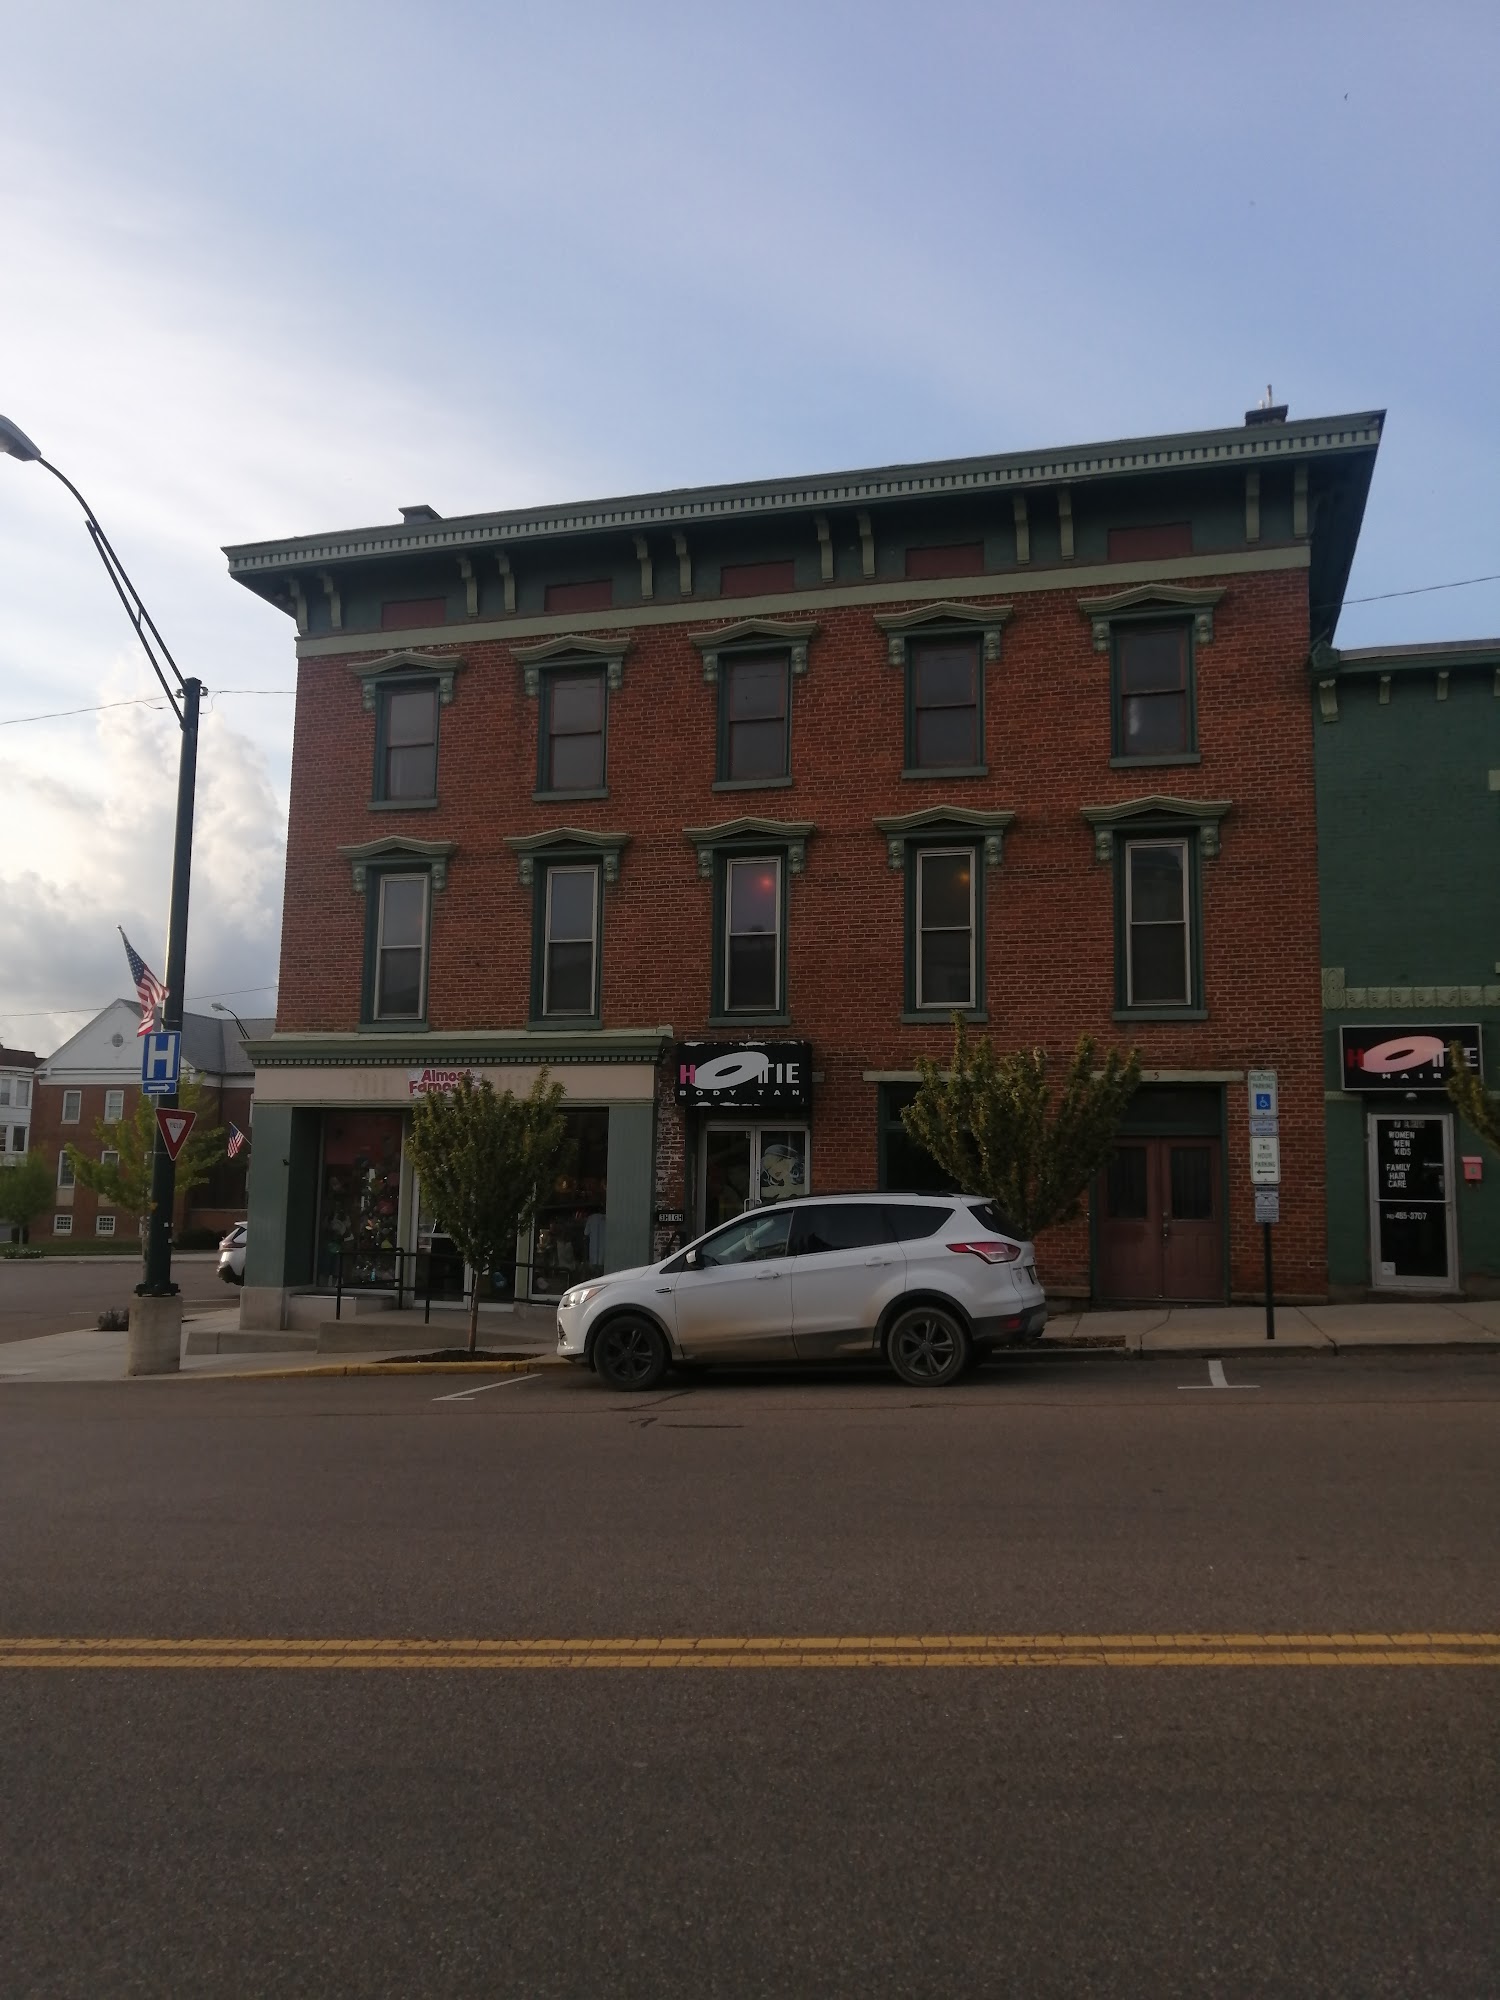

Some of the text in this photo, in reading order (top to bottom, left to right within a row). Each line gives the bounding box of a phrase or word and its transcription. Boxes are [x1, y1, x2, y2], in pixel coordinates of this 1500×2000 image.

[146, 1035, 176, 1079] H
[1388, 1131, 1416, 1140] WOMEN
[1393, 1139, 1411, 1148] MEN
[1394, 1148, 1412, 1156] KIDS
[1386, 1163, 1411, 1172] FAMILY
[1389, 1172, 1406, 1180] HAIR
[1388, 1180, 1408, 1189] CARE
